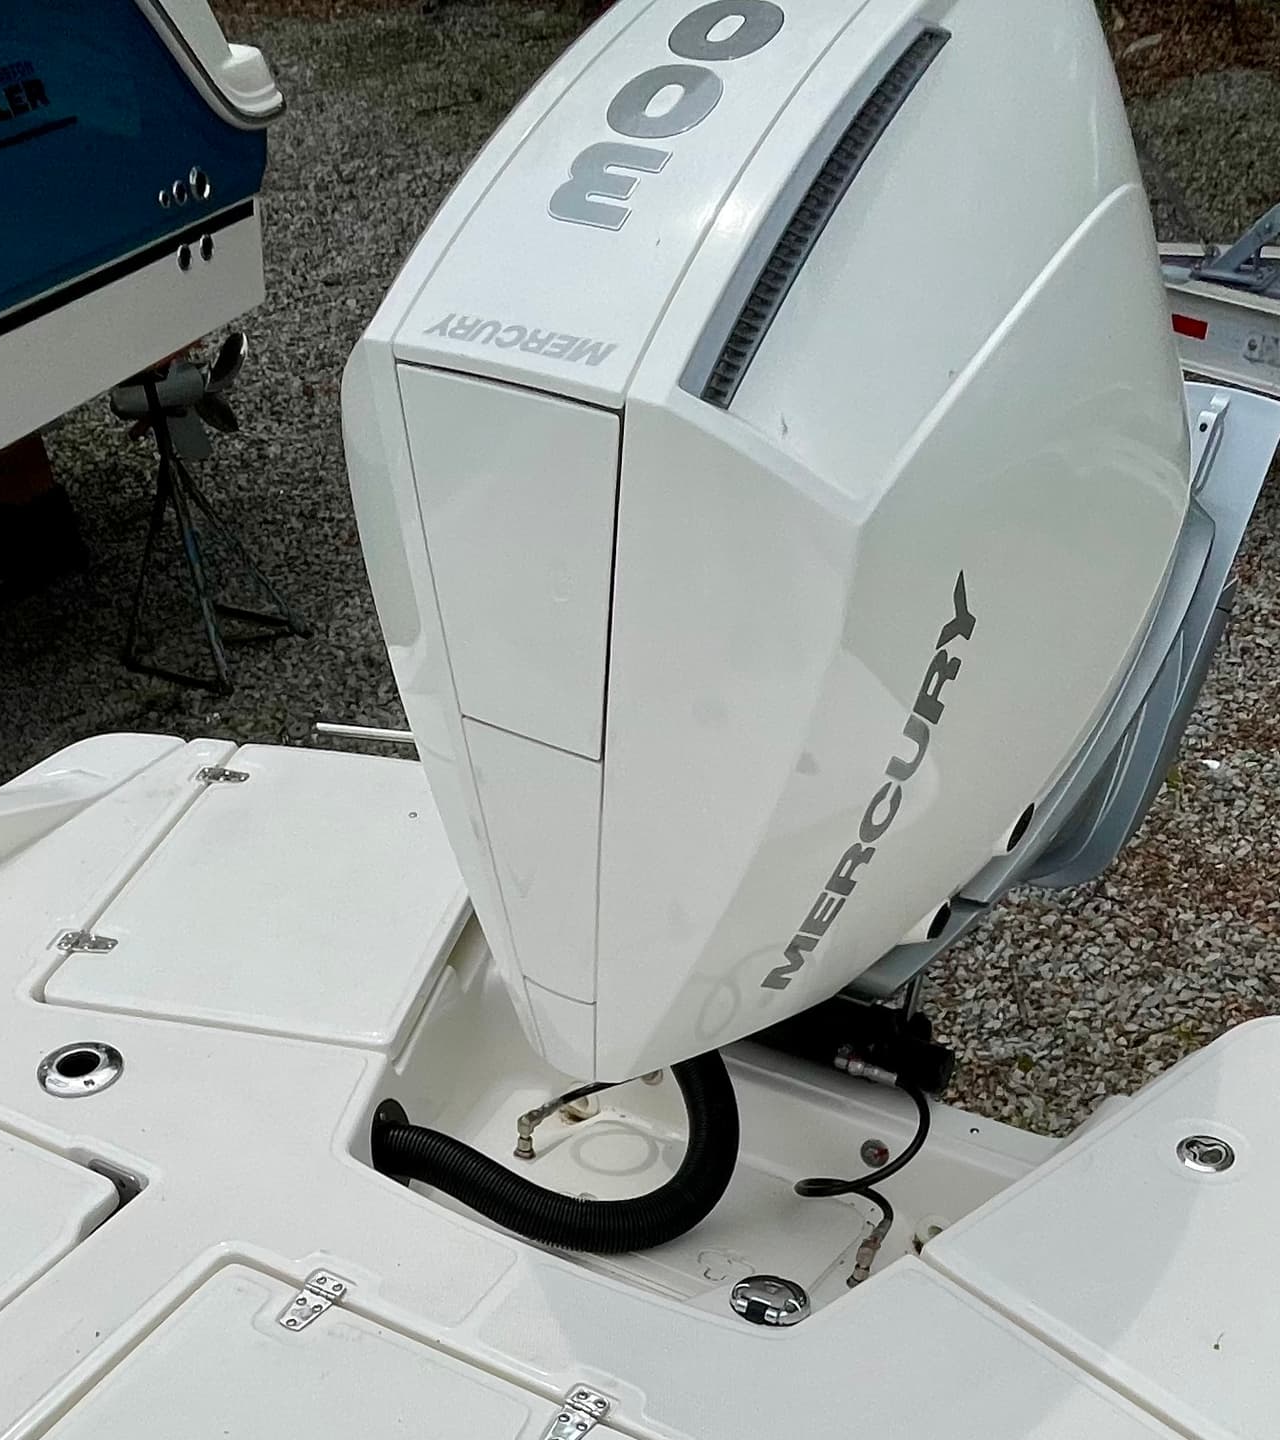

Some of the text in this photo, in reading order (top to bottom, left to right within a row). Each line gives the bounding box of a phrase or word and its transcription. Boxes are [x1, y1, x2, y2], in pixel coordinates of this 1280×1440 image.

[548, 0, 785, 232] 300
[423, 312, 619, 367] MERCURY
[760, 569, 977, 990] MERCURY
